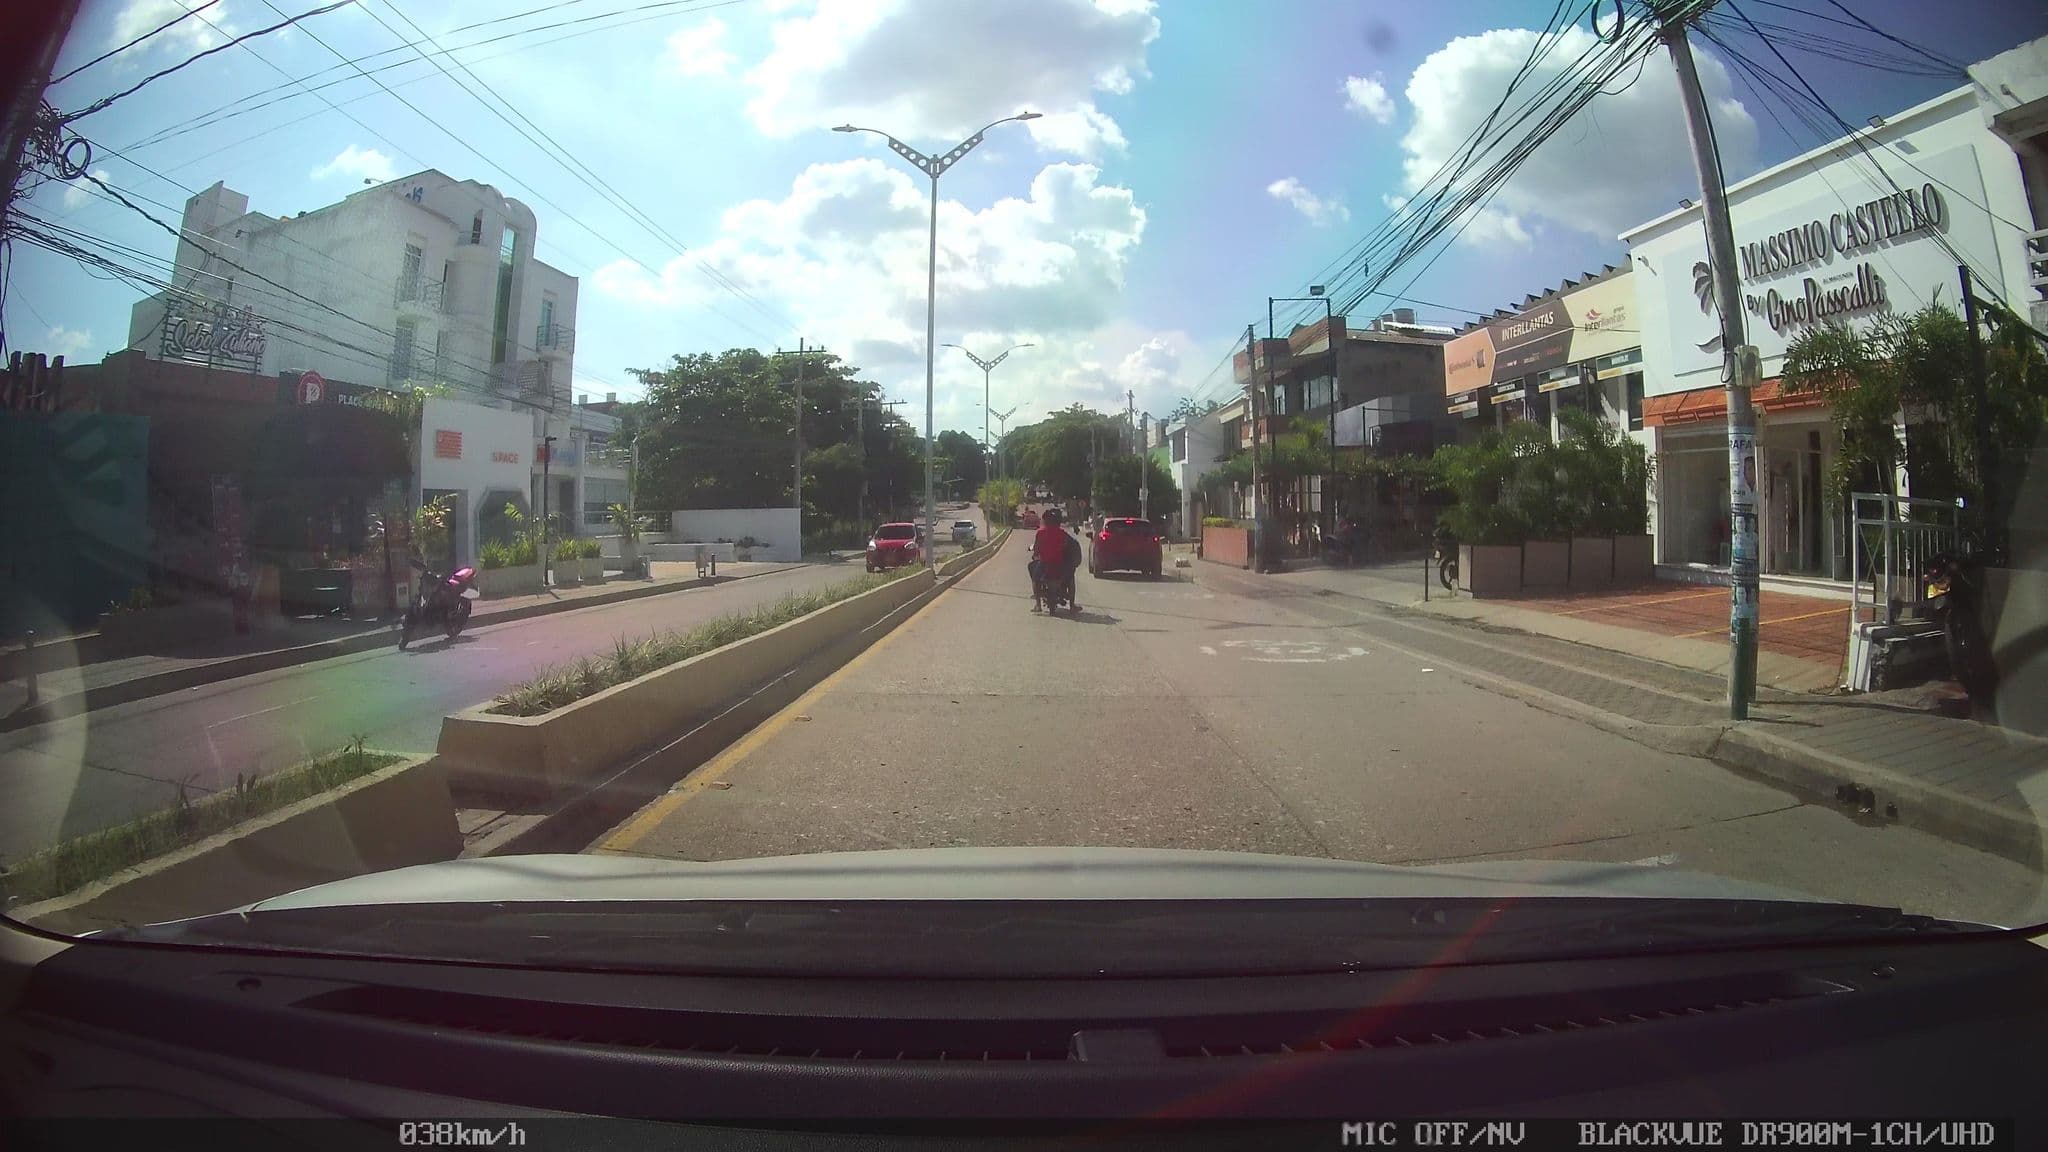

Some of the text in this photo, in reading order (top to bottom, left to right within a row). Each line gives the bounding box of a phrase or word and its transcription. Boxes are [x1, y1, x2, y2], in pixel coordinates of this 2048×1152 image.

[1739, 182, 1943, 281] MASSIMO CASTELLO
[1746, 294, 1761, 312] BY
[1501, 311, 1554, 342] INTERLLANTAS
